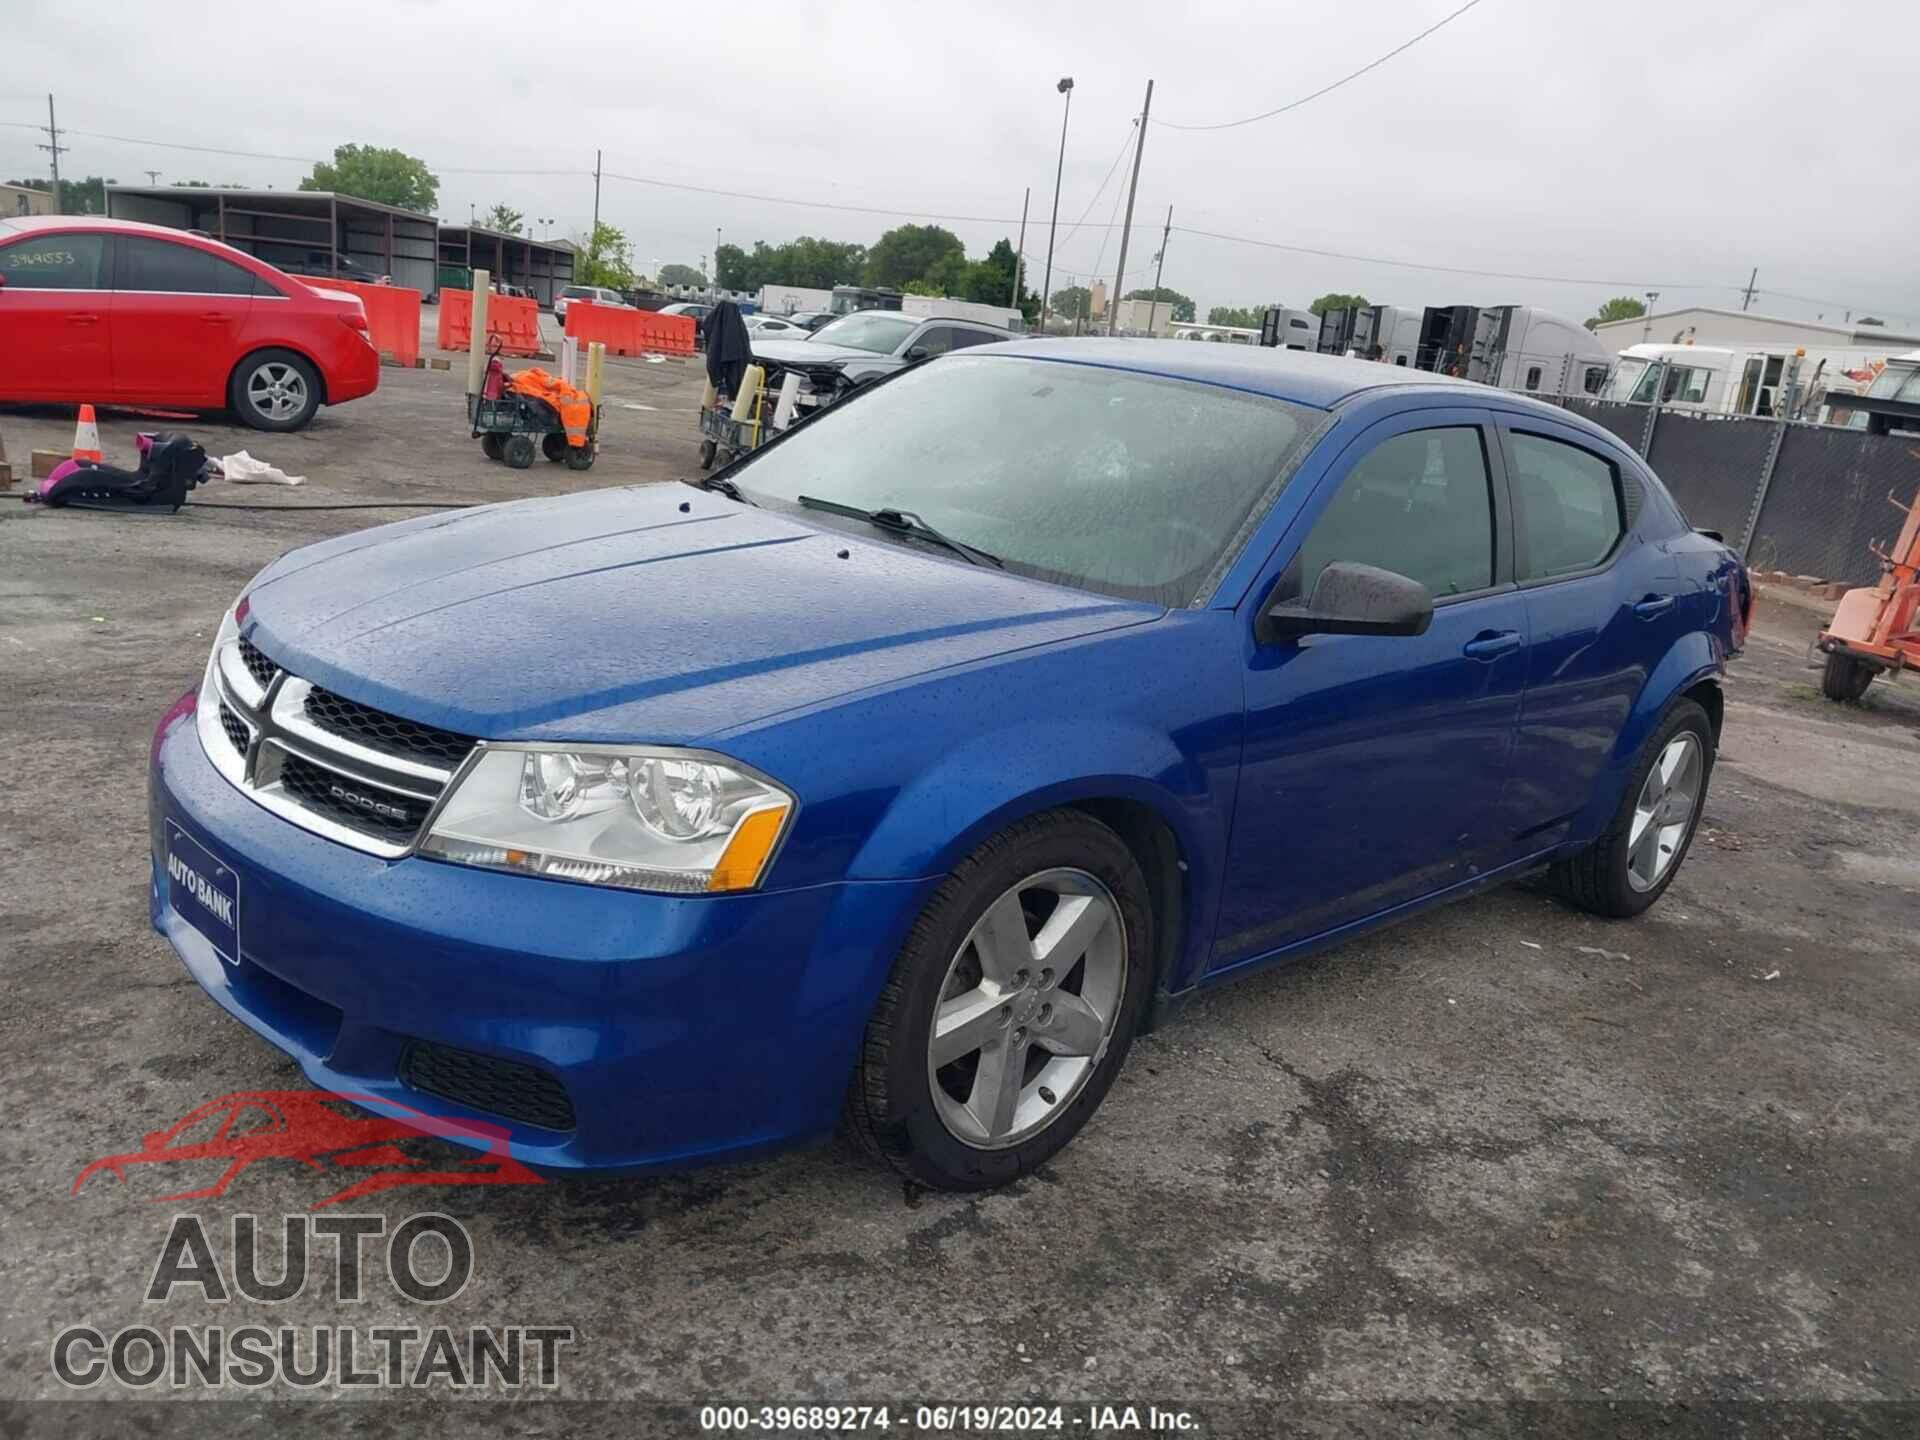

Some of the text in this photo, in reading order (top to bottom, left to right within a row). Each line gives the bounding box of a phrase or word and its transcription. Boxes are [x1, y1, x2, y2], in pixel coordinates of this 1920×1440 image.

[330, 786, 407, 820] DODGE
[168, 852, 233, 926] AUTO BANK
